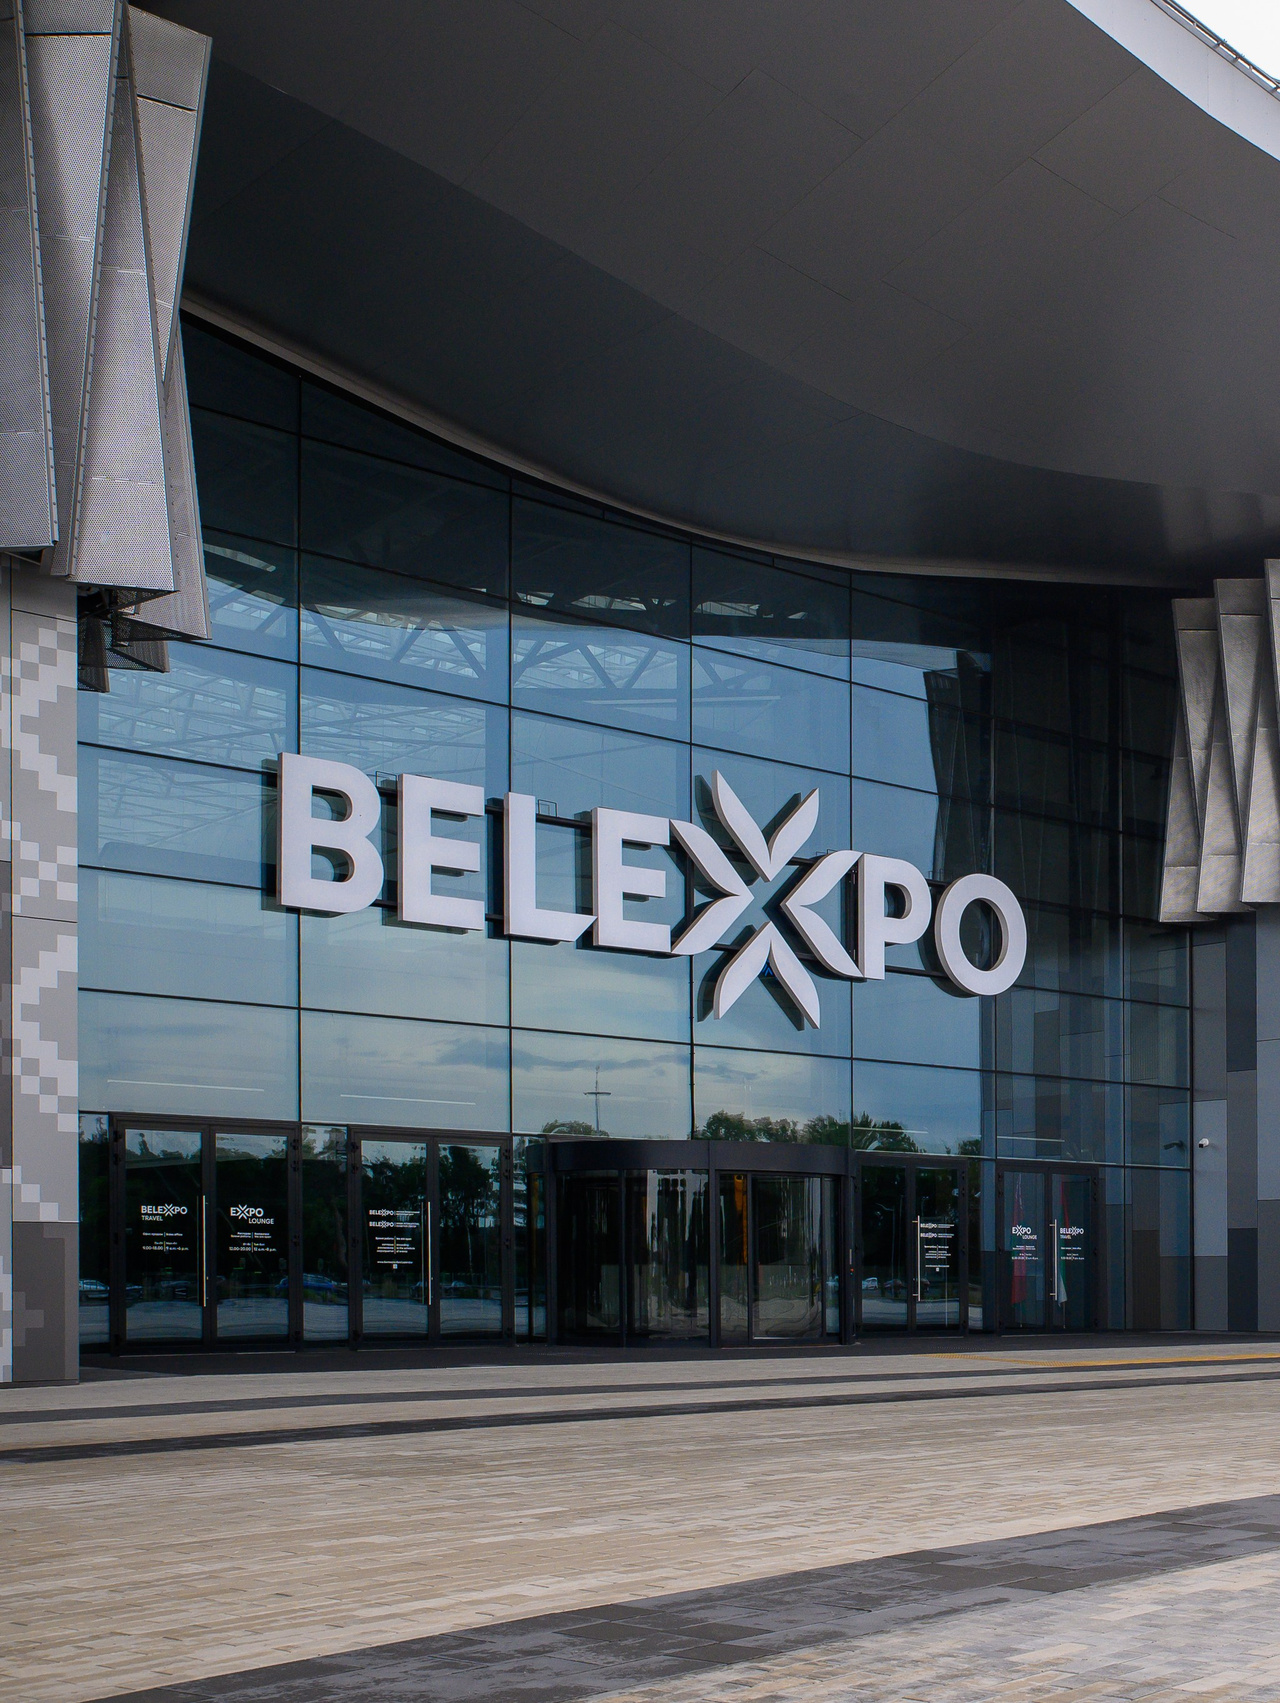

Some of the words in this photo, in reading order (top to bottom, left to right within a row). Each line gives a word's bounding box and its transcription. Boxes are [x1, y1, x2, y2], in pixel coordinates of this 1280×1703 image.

[276, 752, 1027, 1029] BELEXPO
[141, 1203, 188, 1216] BELEXPO
[230, 1204, 264, 1219] EXPO
[1012, 1225, 1031, 1236] EXPO
[1060, 1226, 1084, 1236] BELEXPO
